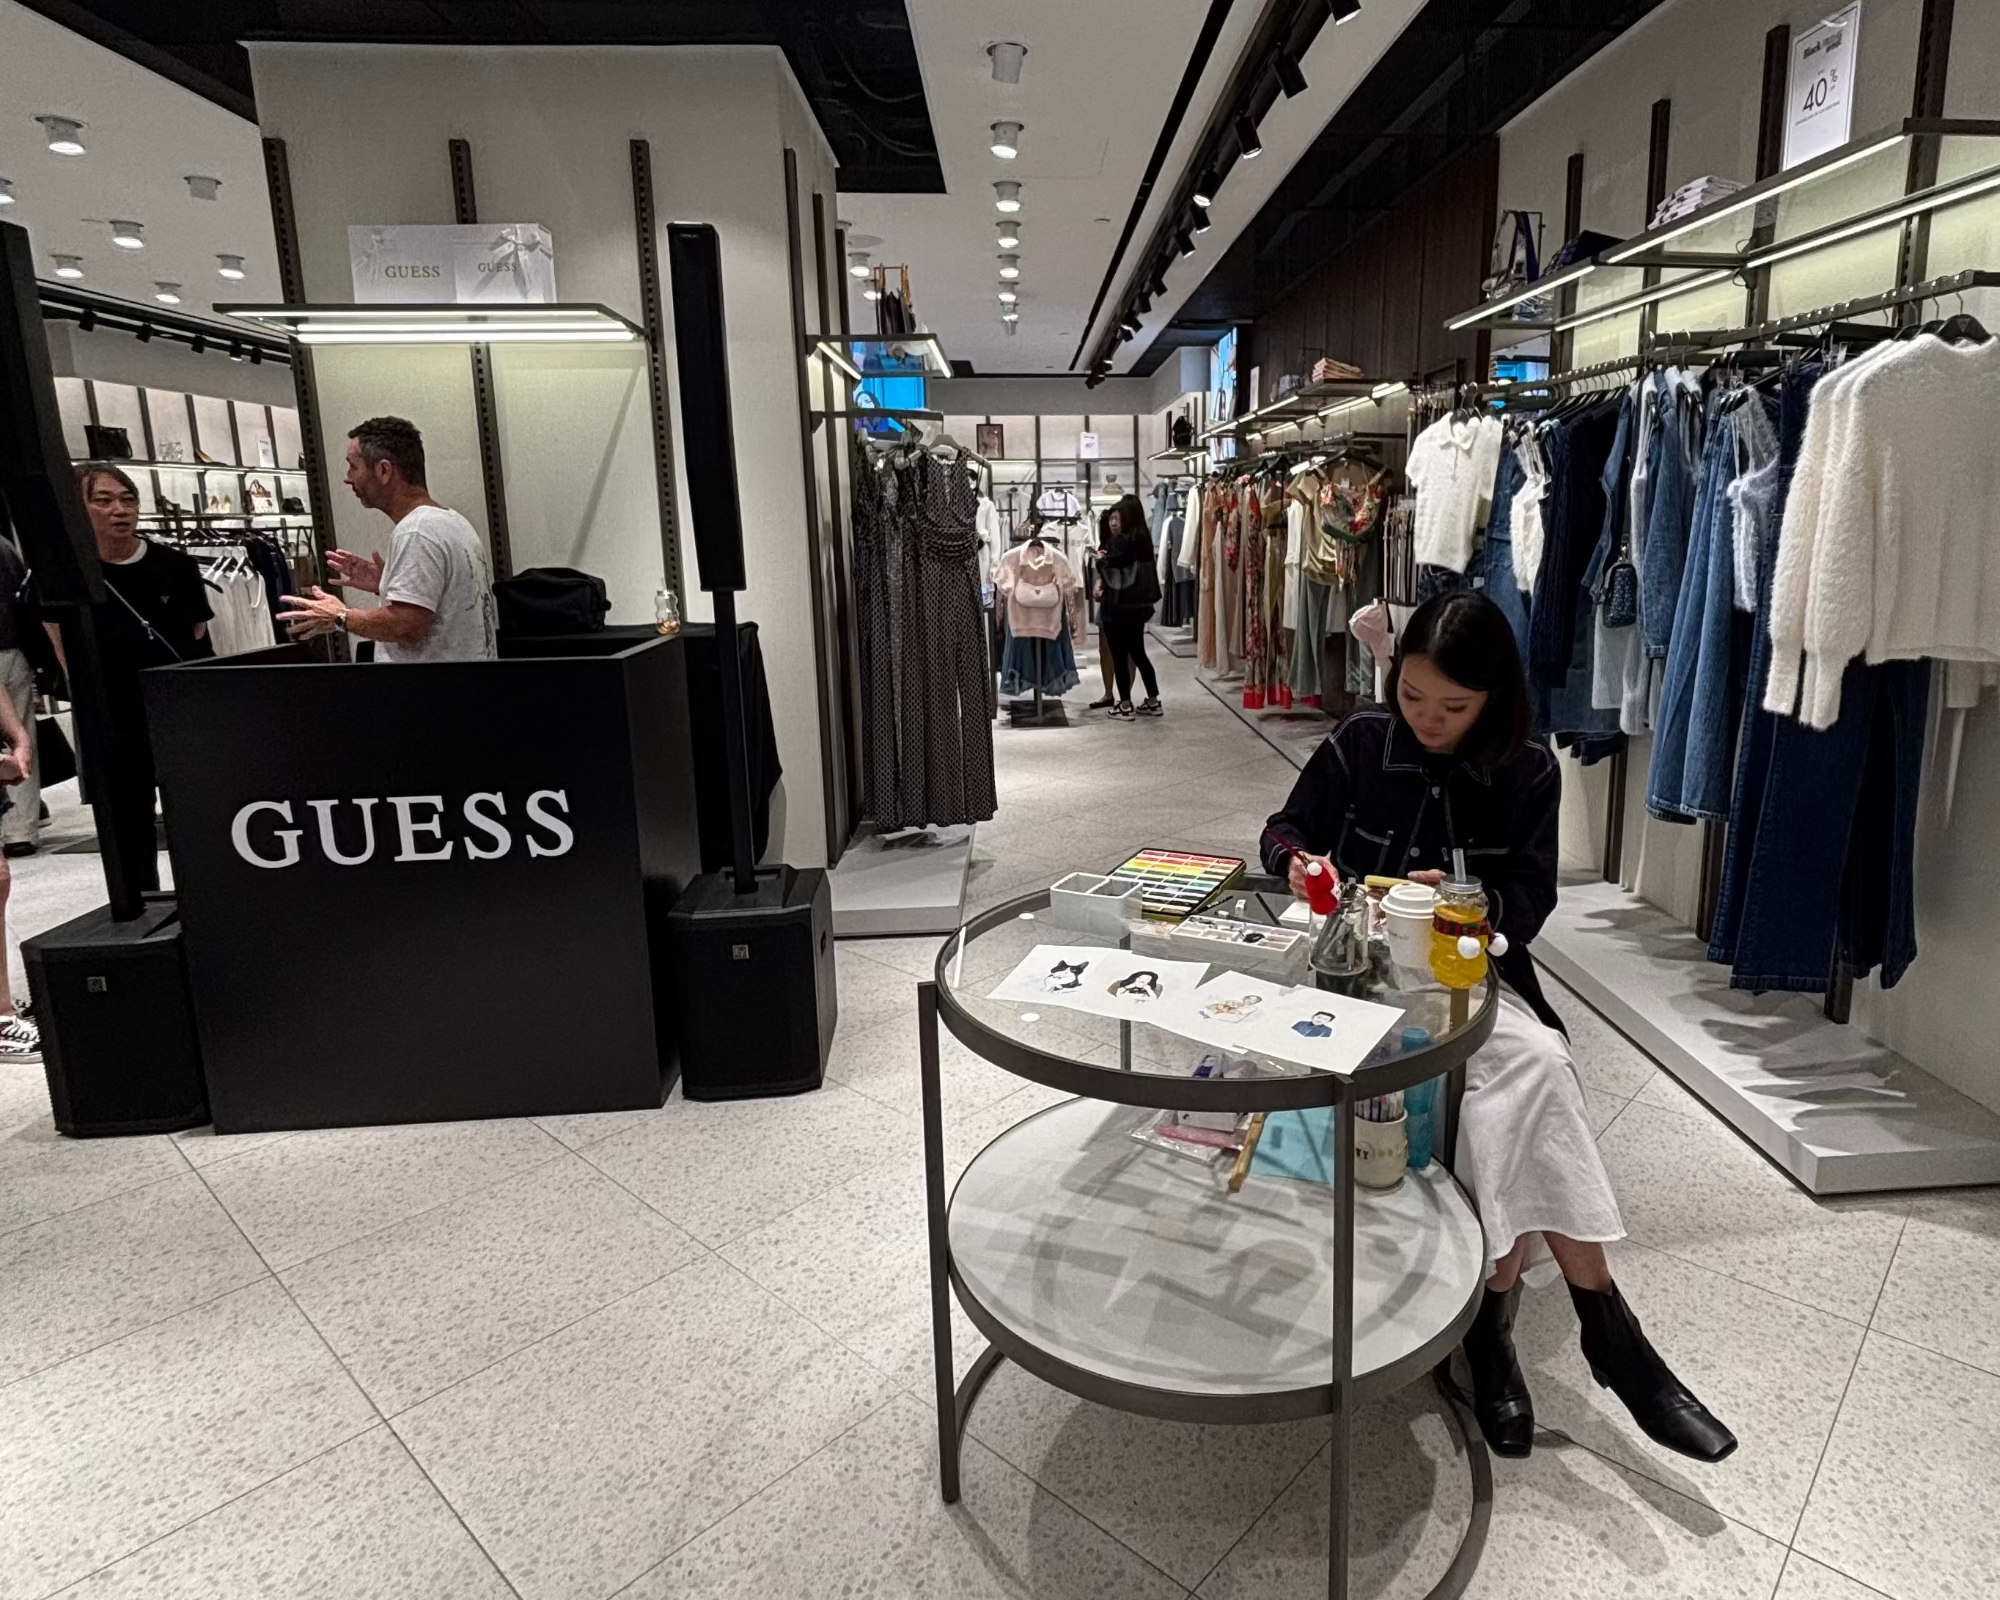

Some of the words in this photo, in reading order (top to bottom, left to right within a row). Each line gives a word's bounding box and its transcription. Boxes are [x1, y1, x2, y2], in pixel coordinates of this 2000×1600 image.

[385, 265, 440, 278] GUESS
[477, 262, 518, 273] GUESS
[231, 789, 575, 869] GUESS
